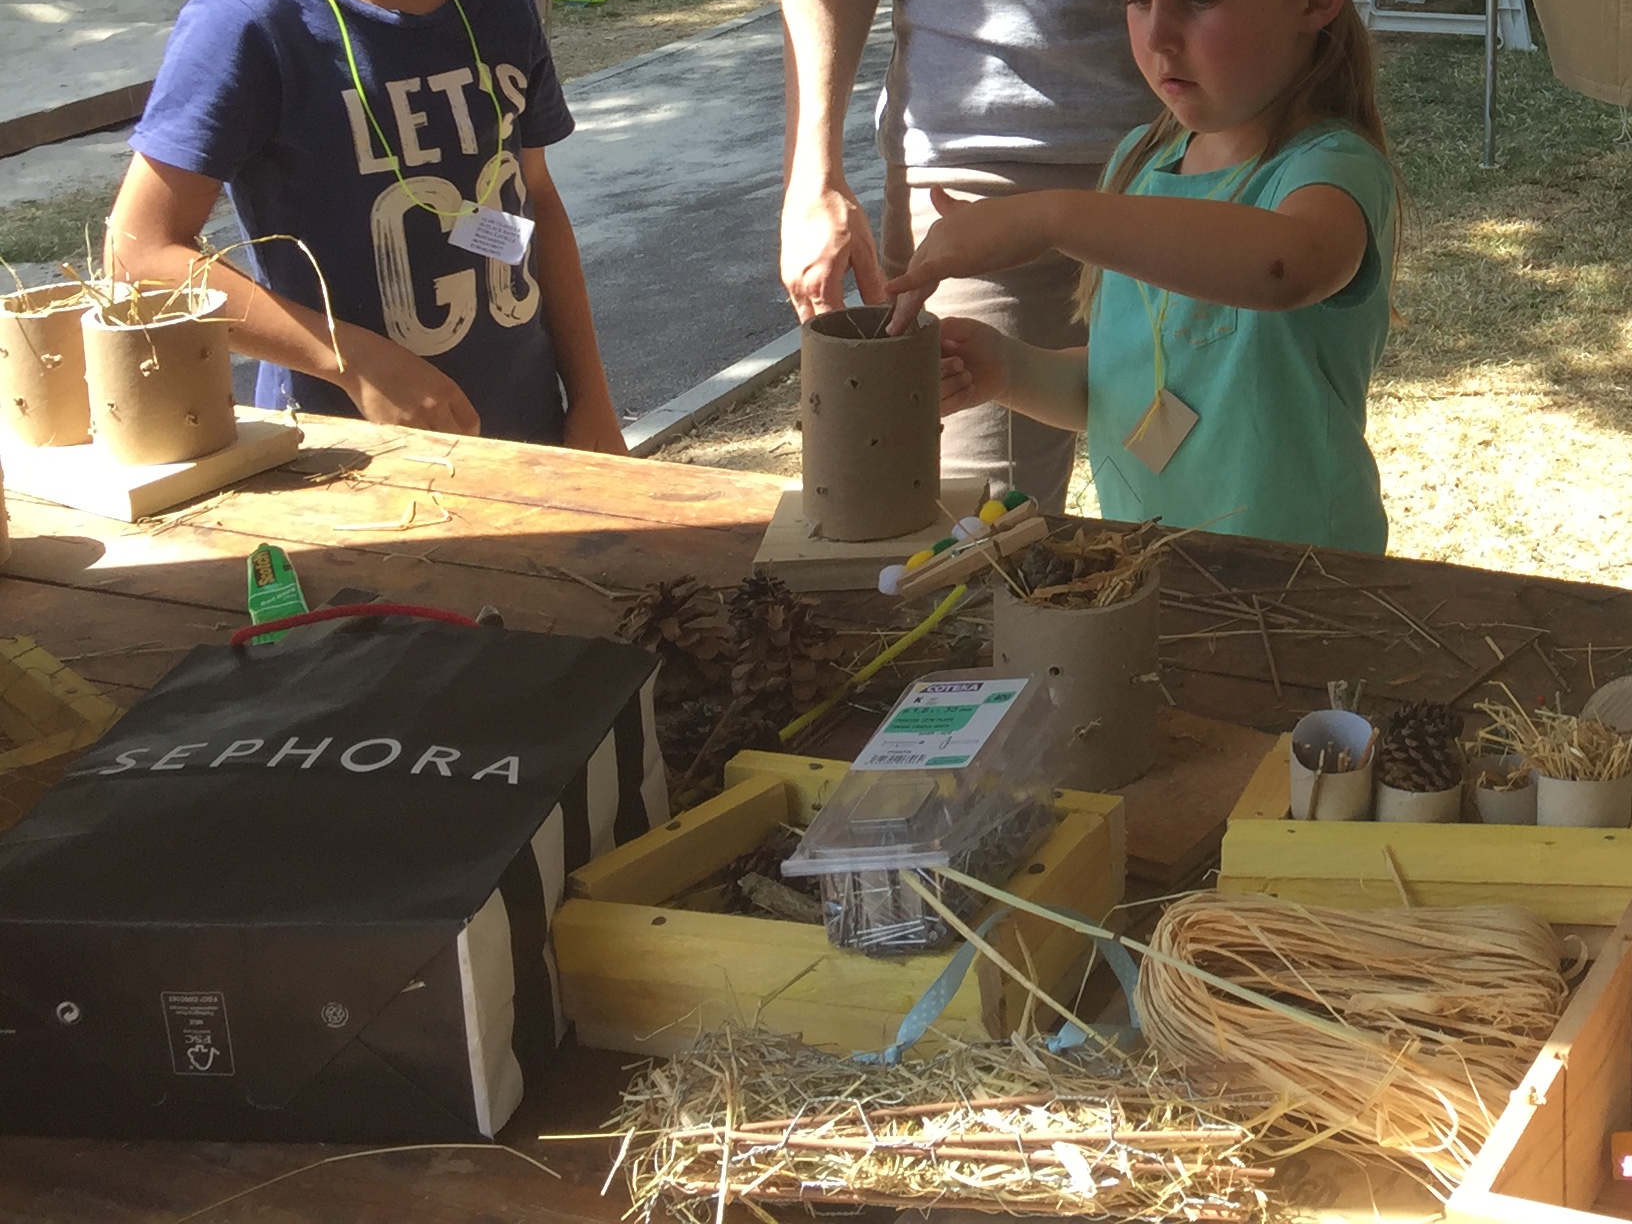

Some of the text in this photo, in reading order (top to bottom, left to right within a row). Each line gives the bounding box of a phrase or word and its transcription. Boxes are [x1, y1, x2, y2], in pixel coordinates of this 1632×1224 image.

[342, 62, 529, 176] LET'S
[370, 150, 541, 357] GO
[98, 736, 521, 785] SEPHORA
